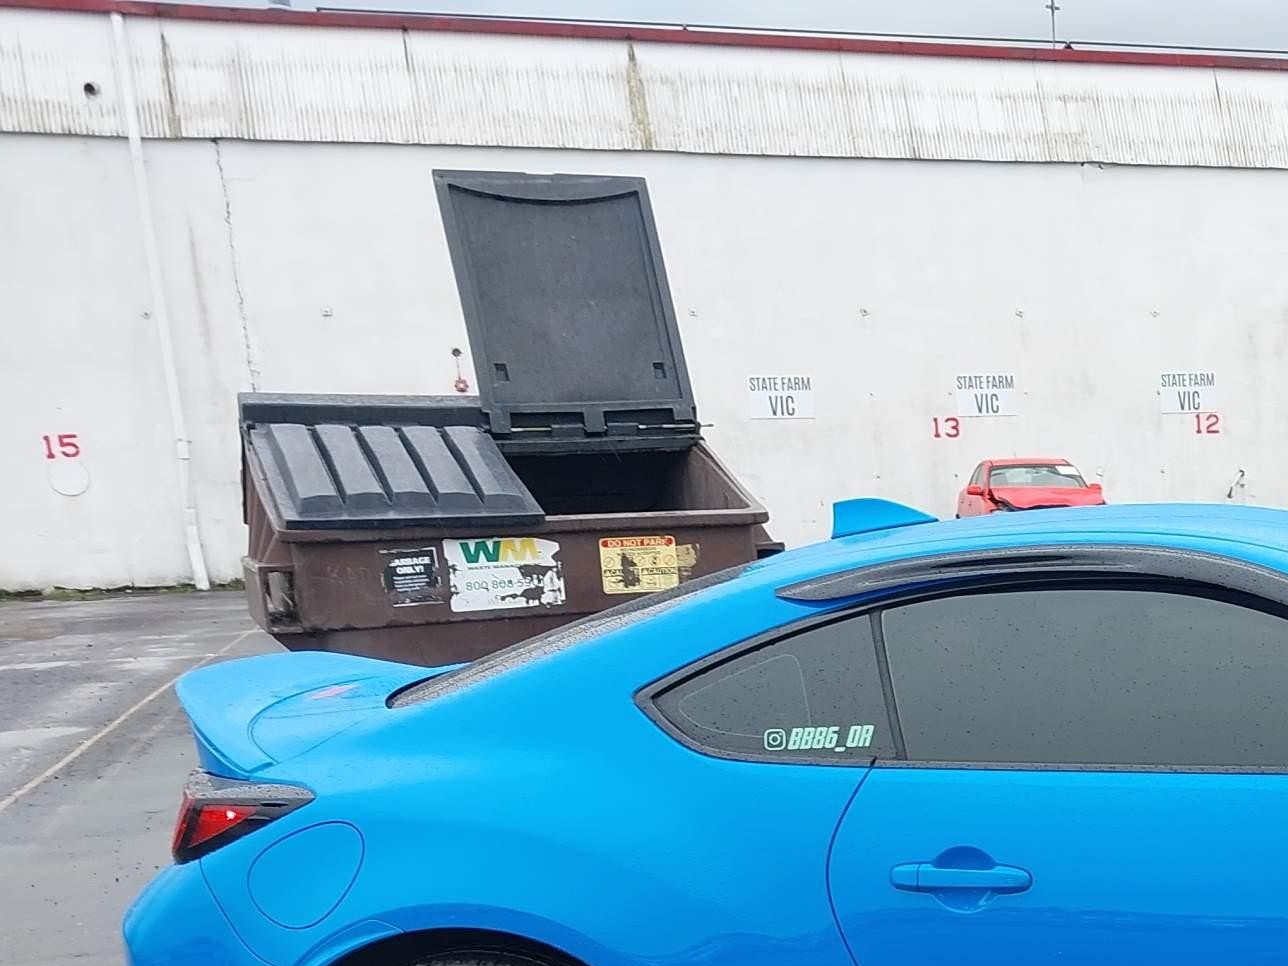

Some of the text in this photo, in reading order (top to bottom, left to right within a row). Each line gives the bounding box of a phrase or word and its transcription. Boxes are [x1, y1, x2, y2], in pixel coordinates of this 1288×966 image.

[749, 376, 811, 392] STATE FARM
[957, 375, 1014, 390] STATE FARM
[1161, 373, 1215, 388] STATE FARM
[768, 395, 795, 416] VIC
[975, 393, 1000, 414] VIC
[1177, 391, 1200, 411] VIC
[932, 417, 960, 438] 13
[1194, 414, 1220, 434] 12
[43, 434, 80, 459] 15
[459, 539, 538, 564] WM
